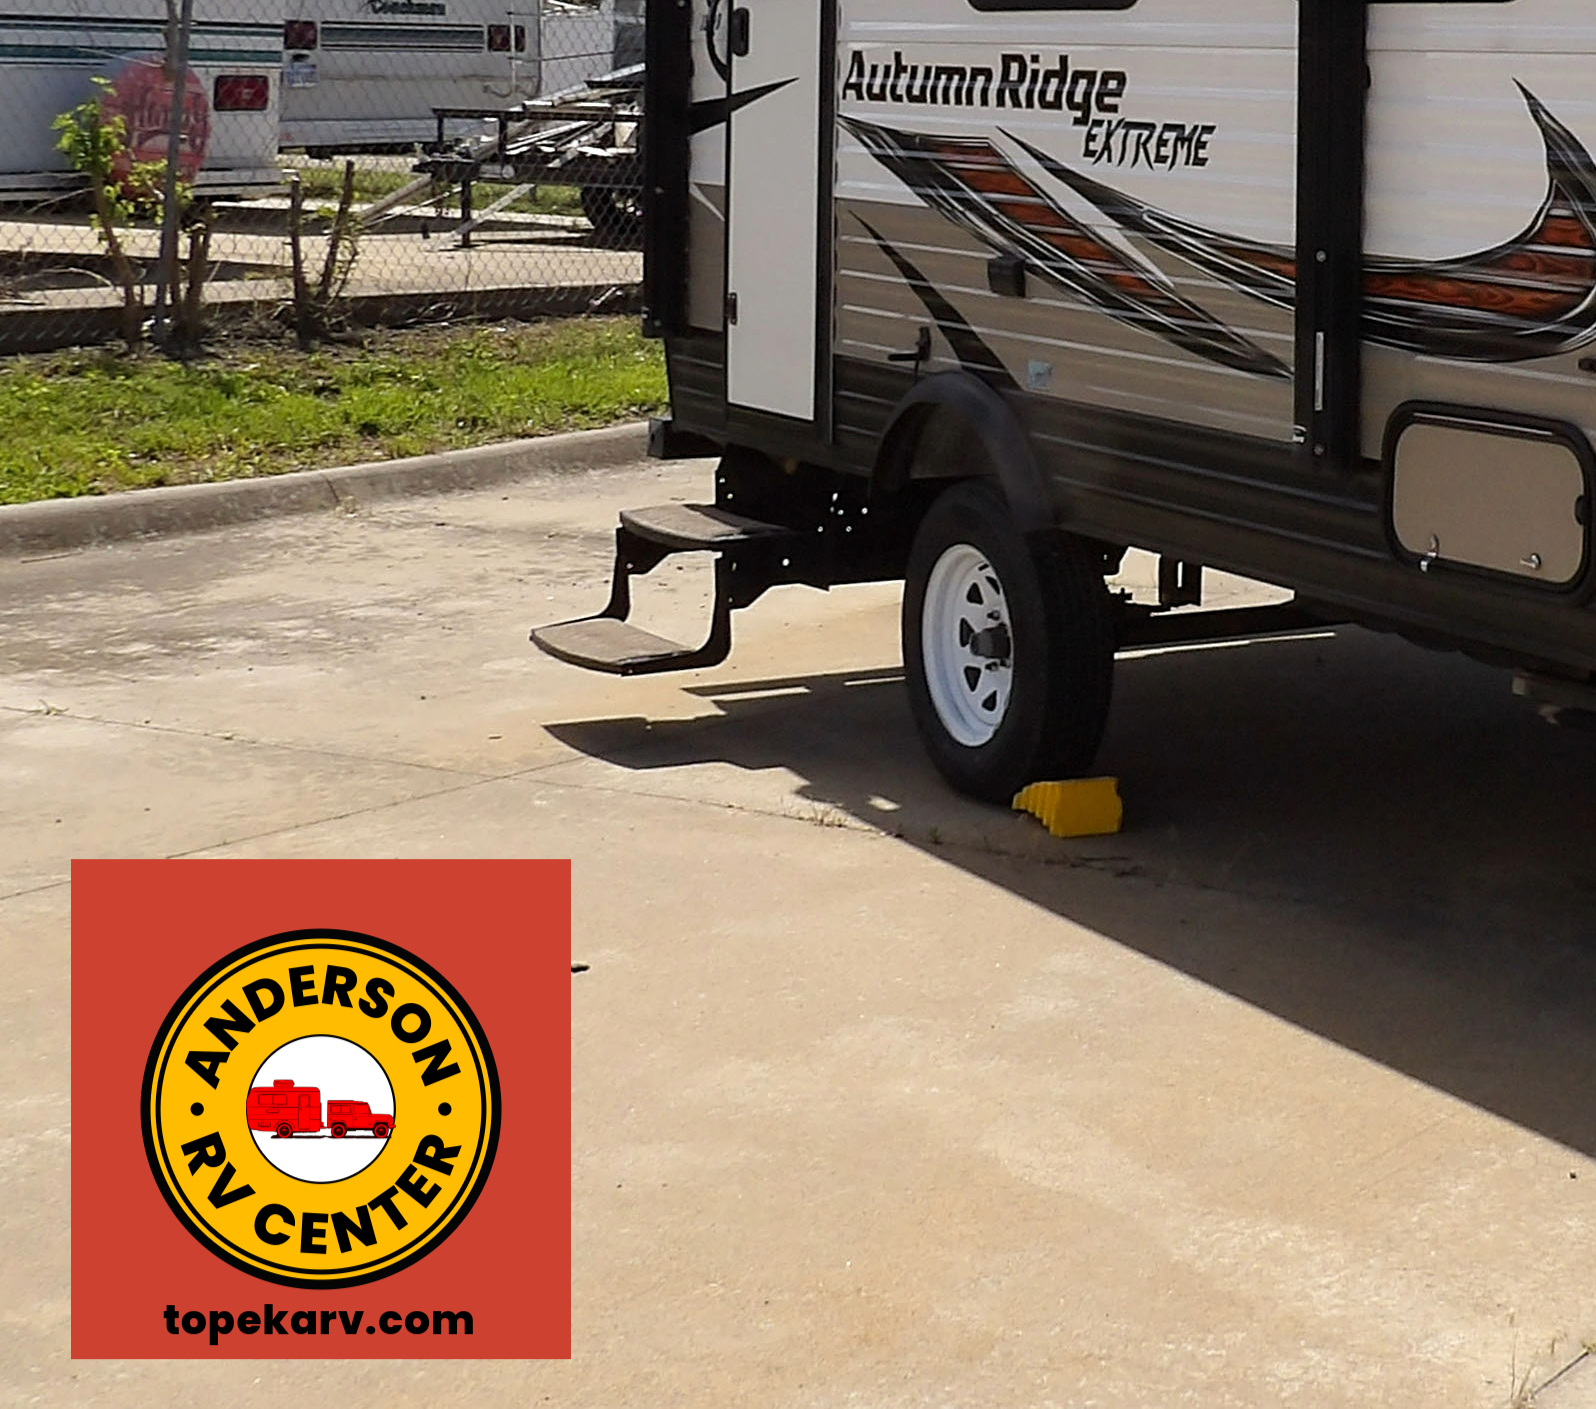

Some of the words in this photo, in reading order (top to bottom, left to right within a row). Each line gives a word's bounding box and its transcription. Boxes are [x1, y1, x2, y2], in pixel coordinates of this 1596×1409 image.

[842, 50, 993, 107] Autumn
[995, 53, 1127, 127] Ridge
[1082, 117, 1217, 171] EXTREME
